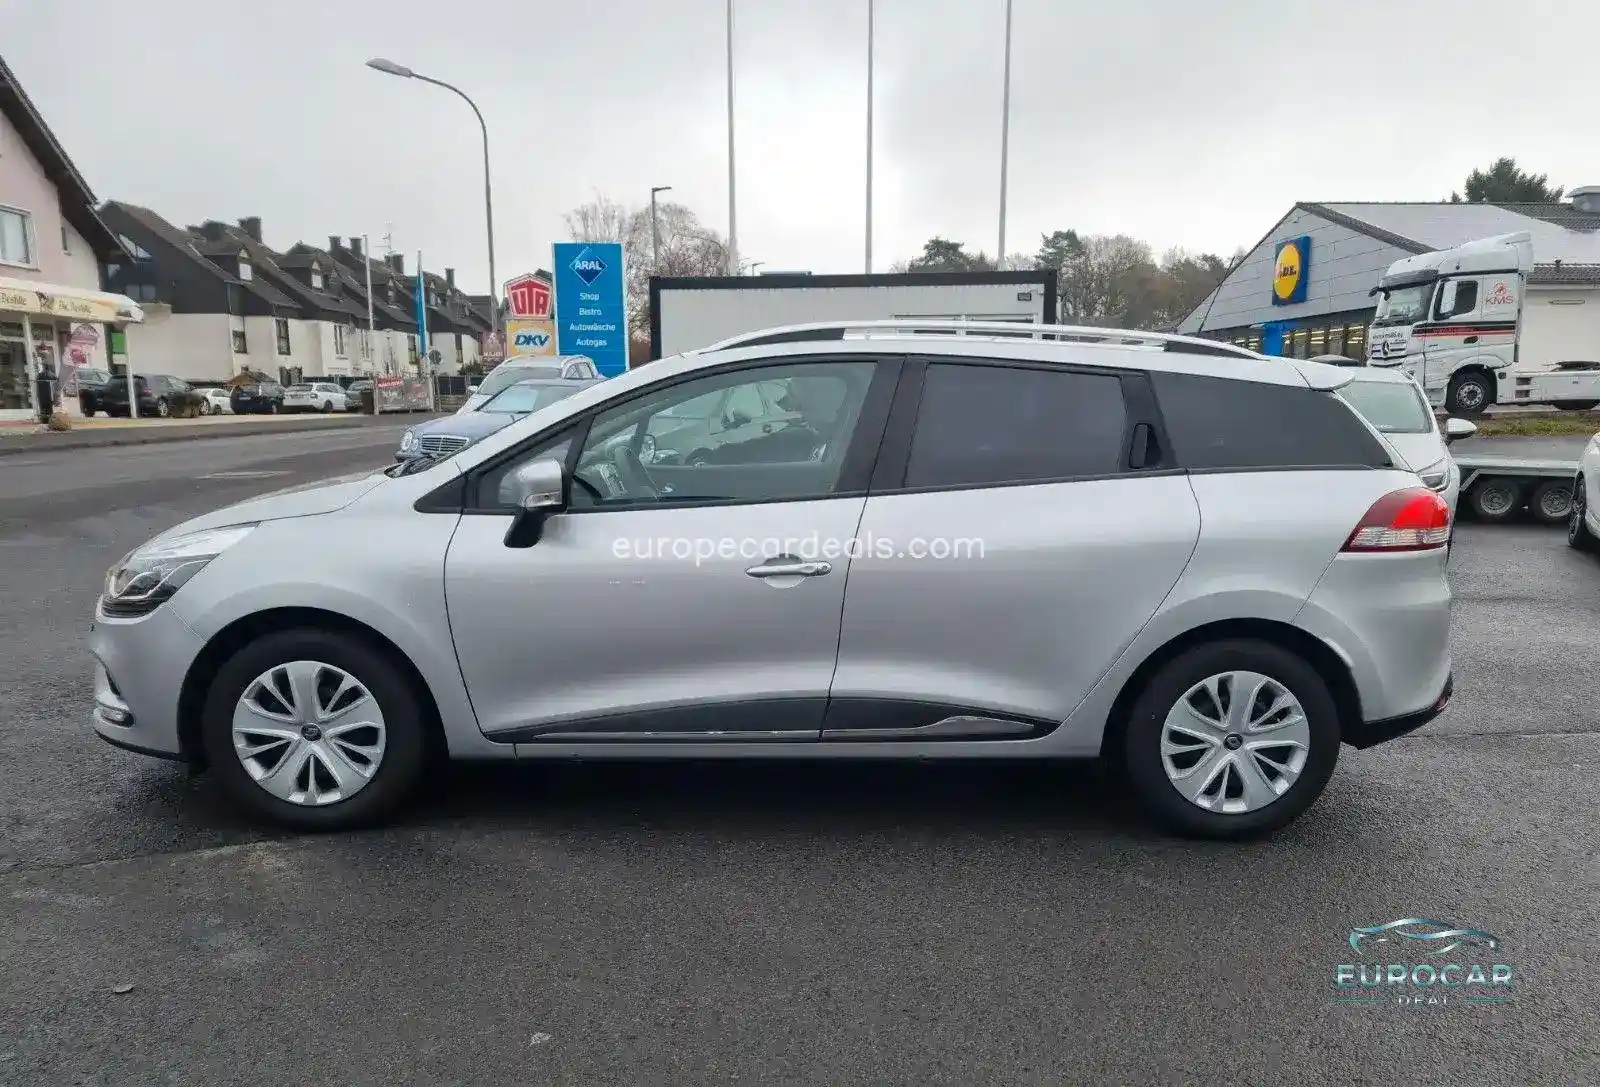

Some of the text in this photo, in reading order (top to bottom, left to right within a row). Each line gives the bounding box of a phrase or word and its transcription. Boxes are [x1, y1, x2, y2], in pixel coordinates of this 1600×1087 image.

[574, 260, 602, 270] ARAL
[579, 292, 600, 301] Shop
[1485, 295, 1514, 305] KMS
[579, 308, 602, 316] Bistro
[569, 322, 616, 331] Autowäsche
[514, 334, 551, 346] DKV
[576, 338, 608, 348] Autogas
